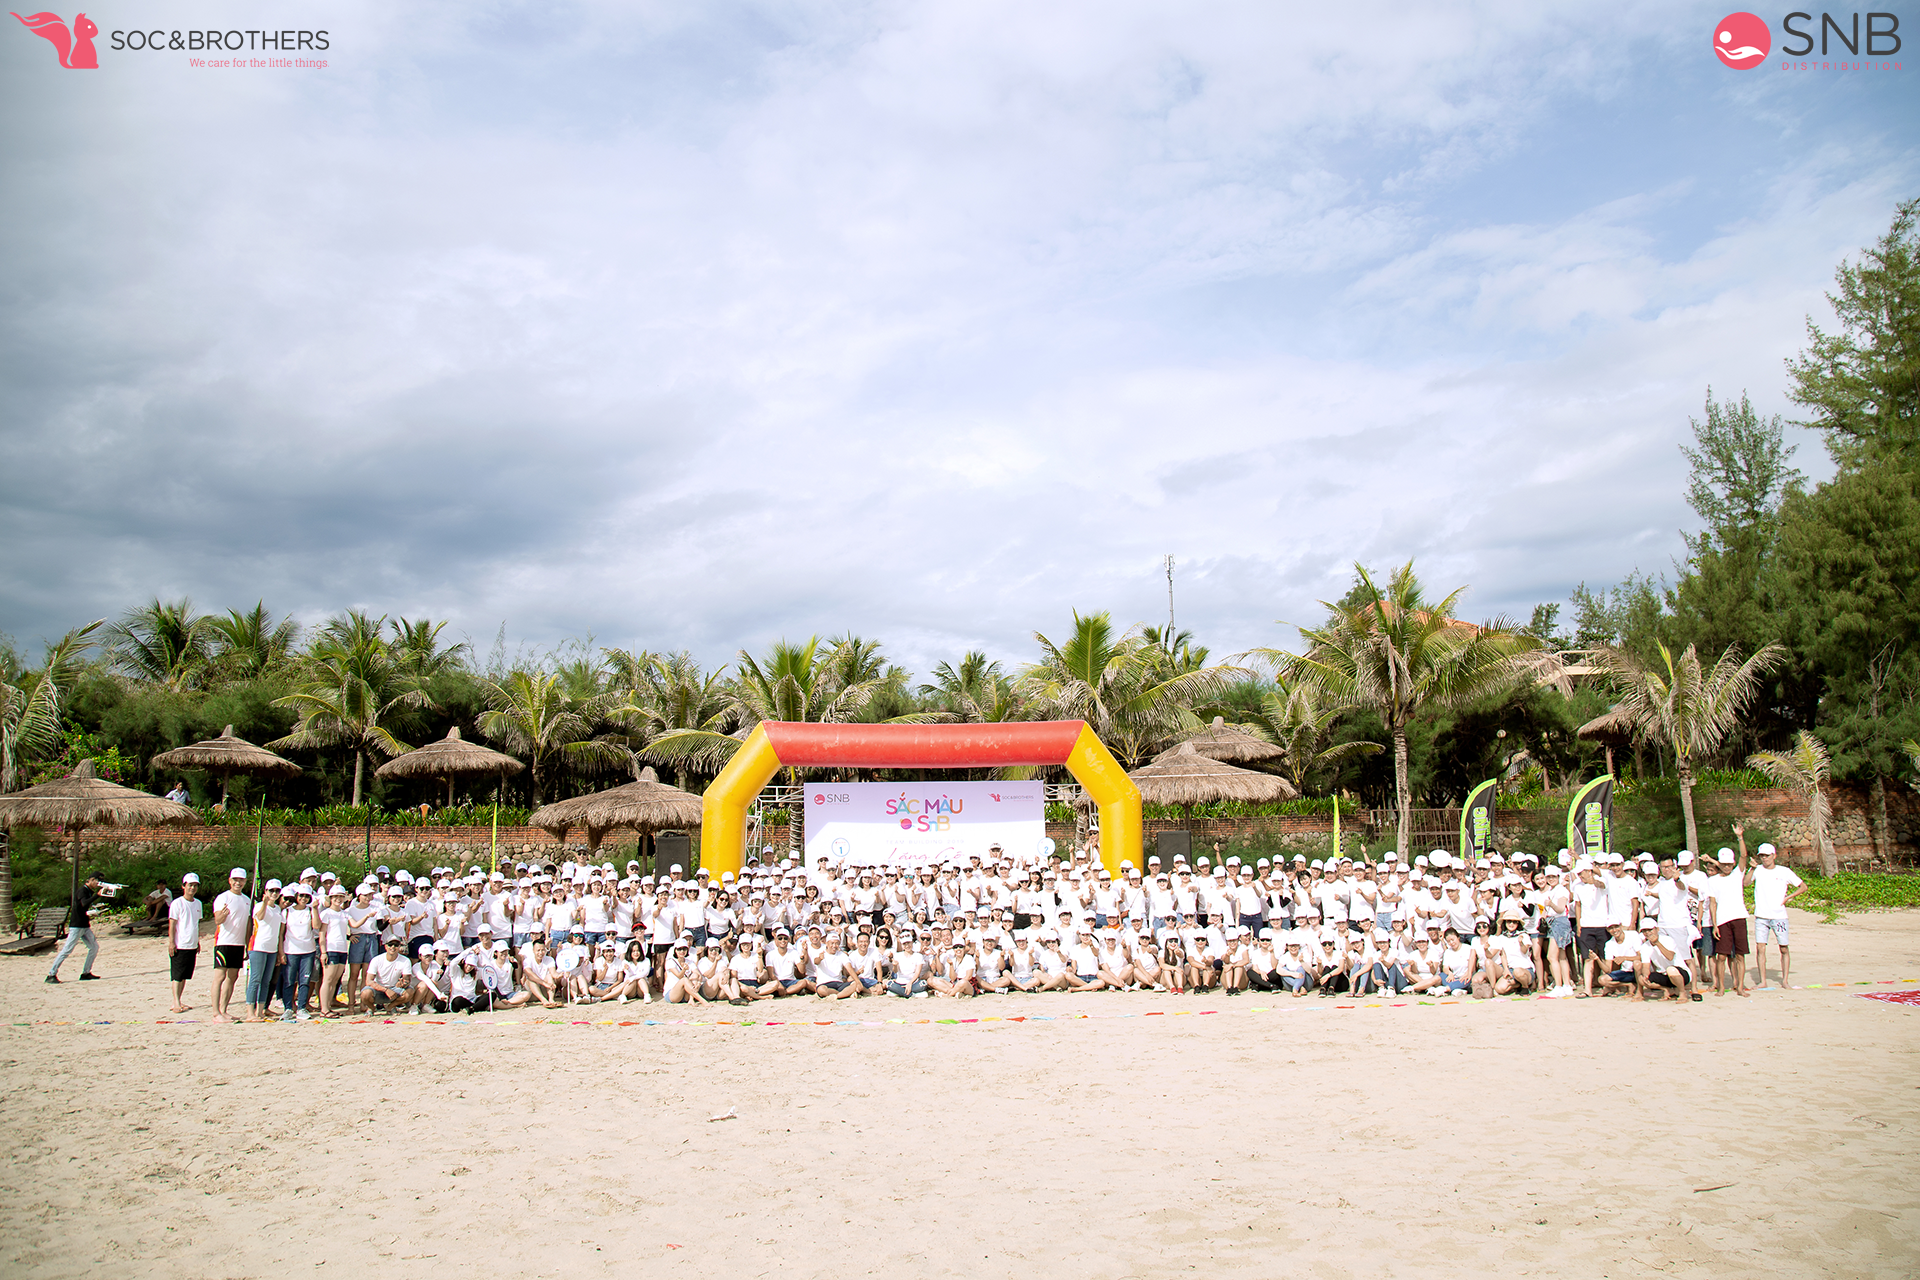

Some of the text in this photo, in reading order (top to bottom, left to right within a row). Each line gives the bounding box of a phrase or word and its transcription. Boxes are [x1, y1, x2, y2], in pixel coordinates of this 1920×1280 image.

[826, 793, 850, 803] SNB
[886, 791, 963, 815] SẮC MÀU
[1044, 846, 1049, 854] 2
[564, 959, 571, 969] 5
[488, 976, 493, 987] 8
